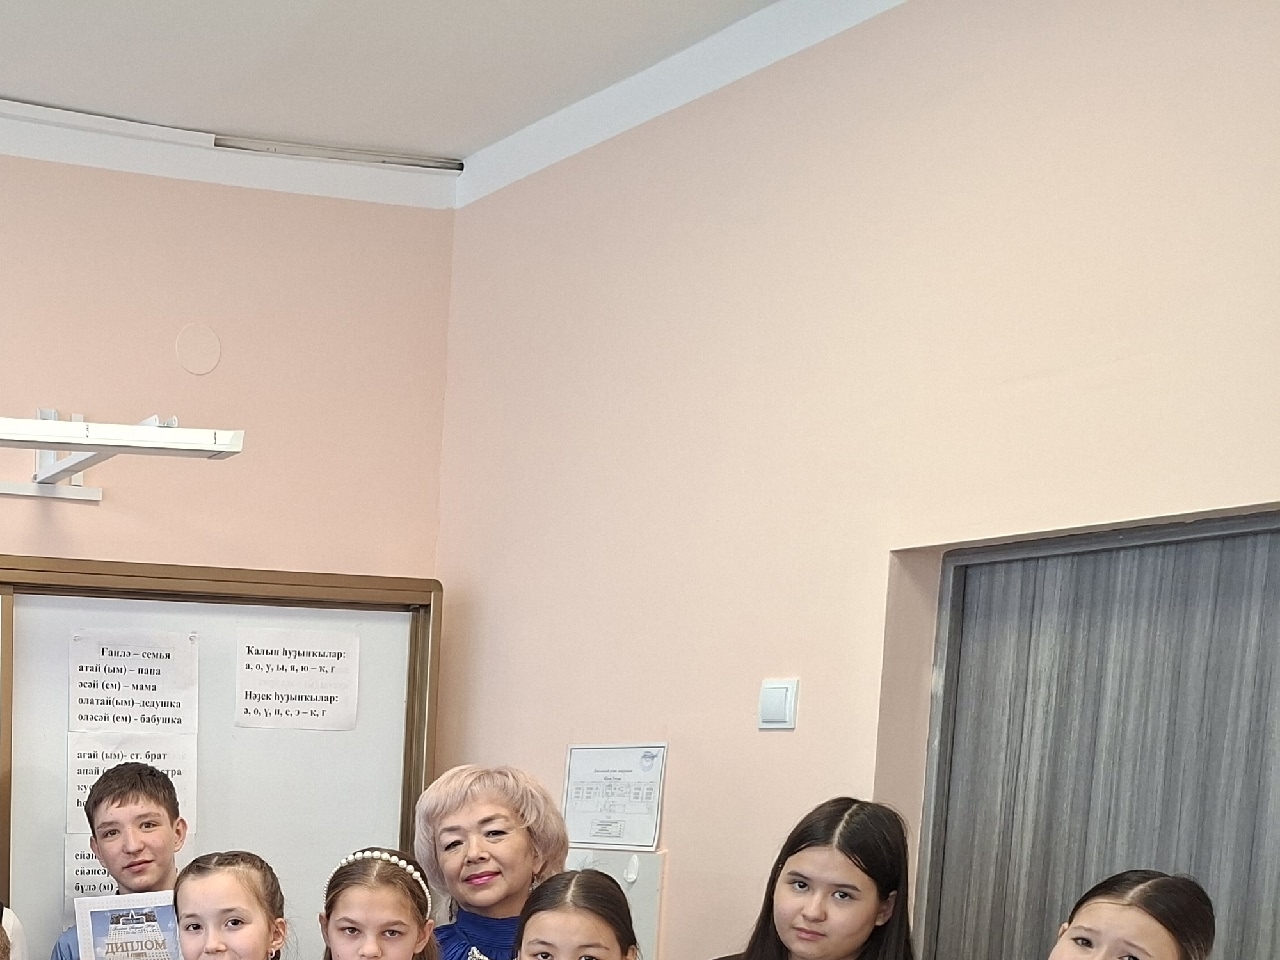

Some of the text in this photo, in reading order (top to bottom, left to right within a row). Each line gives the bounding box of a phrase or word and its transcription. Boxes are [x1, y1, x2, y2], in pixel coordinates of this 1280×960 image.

[141, 651, 171, 660] семья
[137, 667, 161, 675] папа
[131, 683, 157, 692] мама
[140, 714, 182, 726] бабушка
[145, 751, 168, 762] брат
[105, 938, 167, 955] ДИПЛОМ
